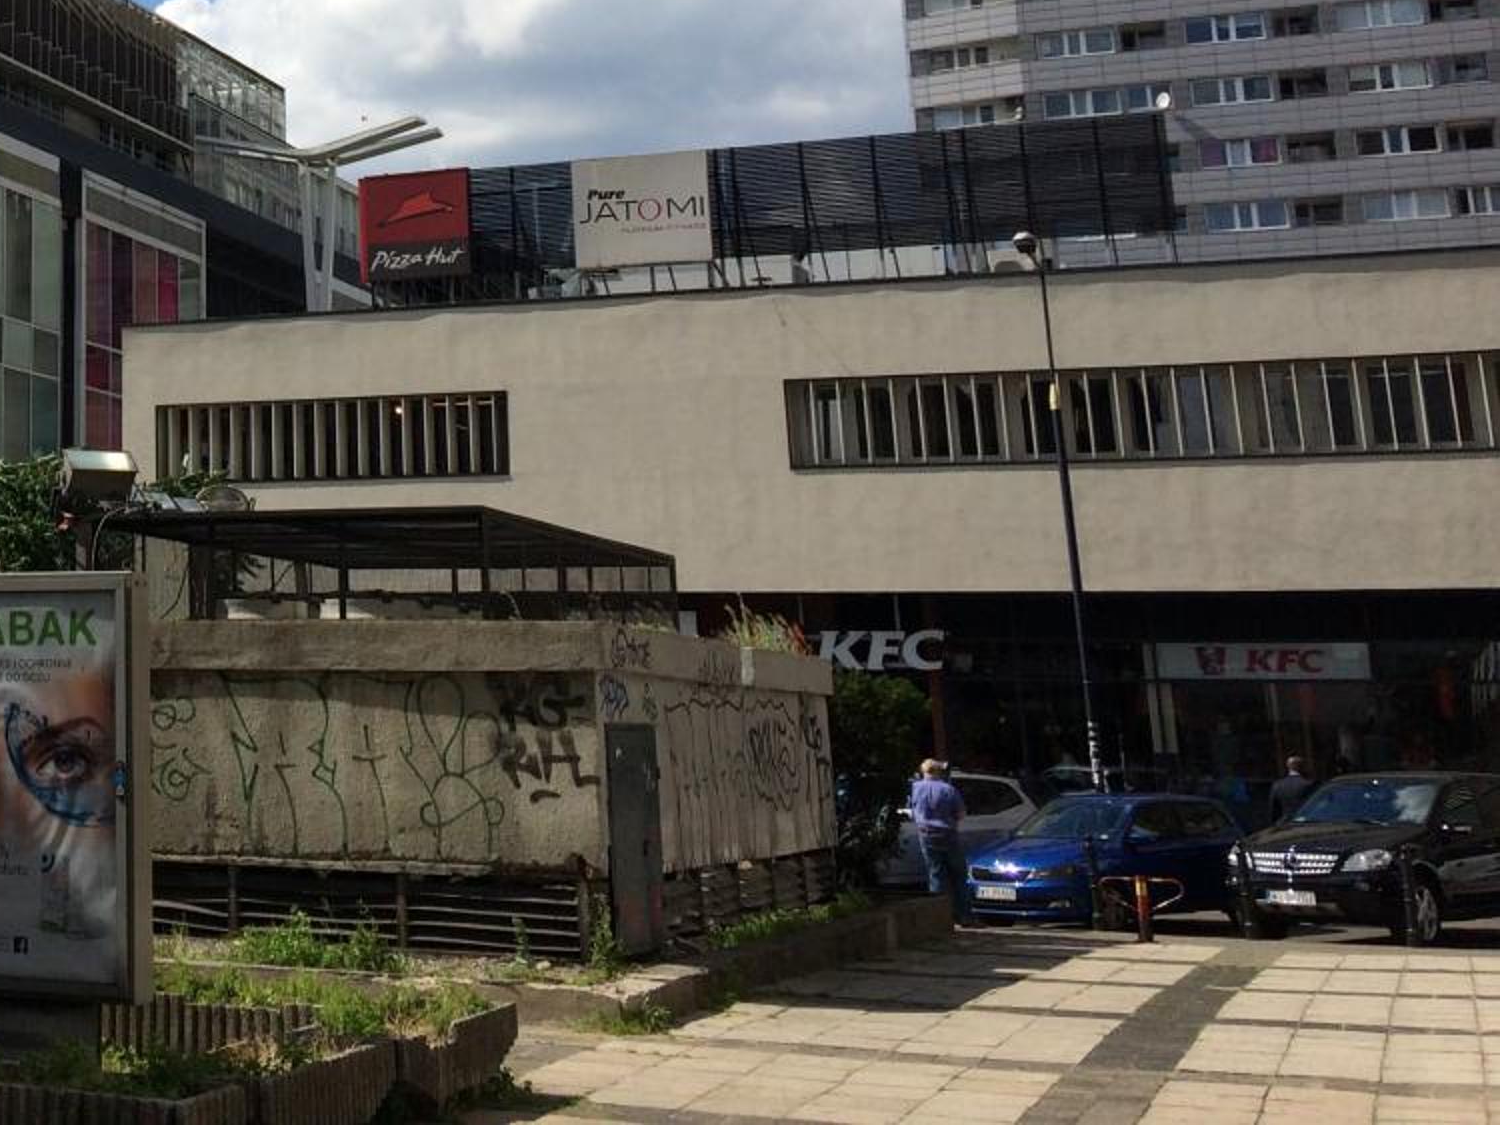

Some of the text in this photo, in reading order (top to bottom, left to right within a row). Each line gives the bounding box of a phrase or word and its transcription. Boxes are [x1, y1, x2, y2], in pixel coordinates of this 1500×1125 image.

[588, 189, 625, 201] Pure
[580, 196, 705, 224] JATOMI
[371, 246, 466, 272] Pizza Hut
[817, 629, 945, 671] KFC
[1244, 649, 1325, 673] KFC
